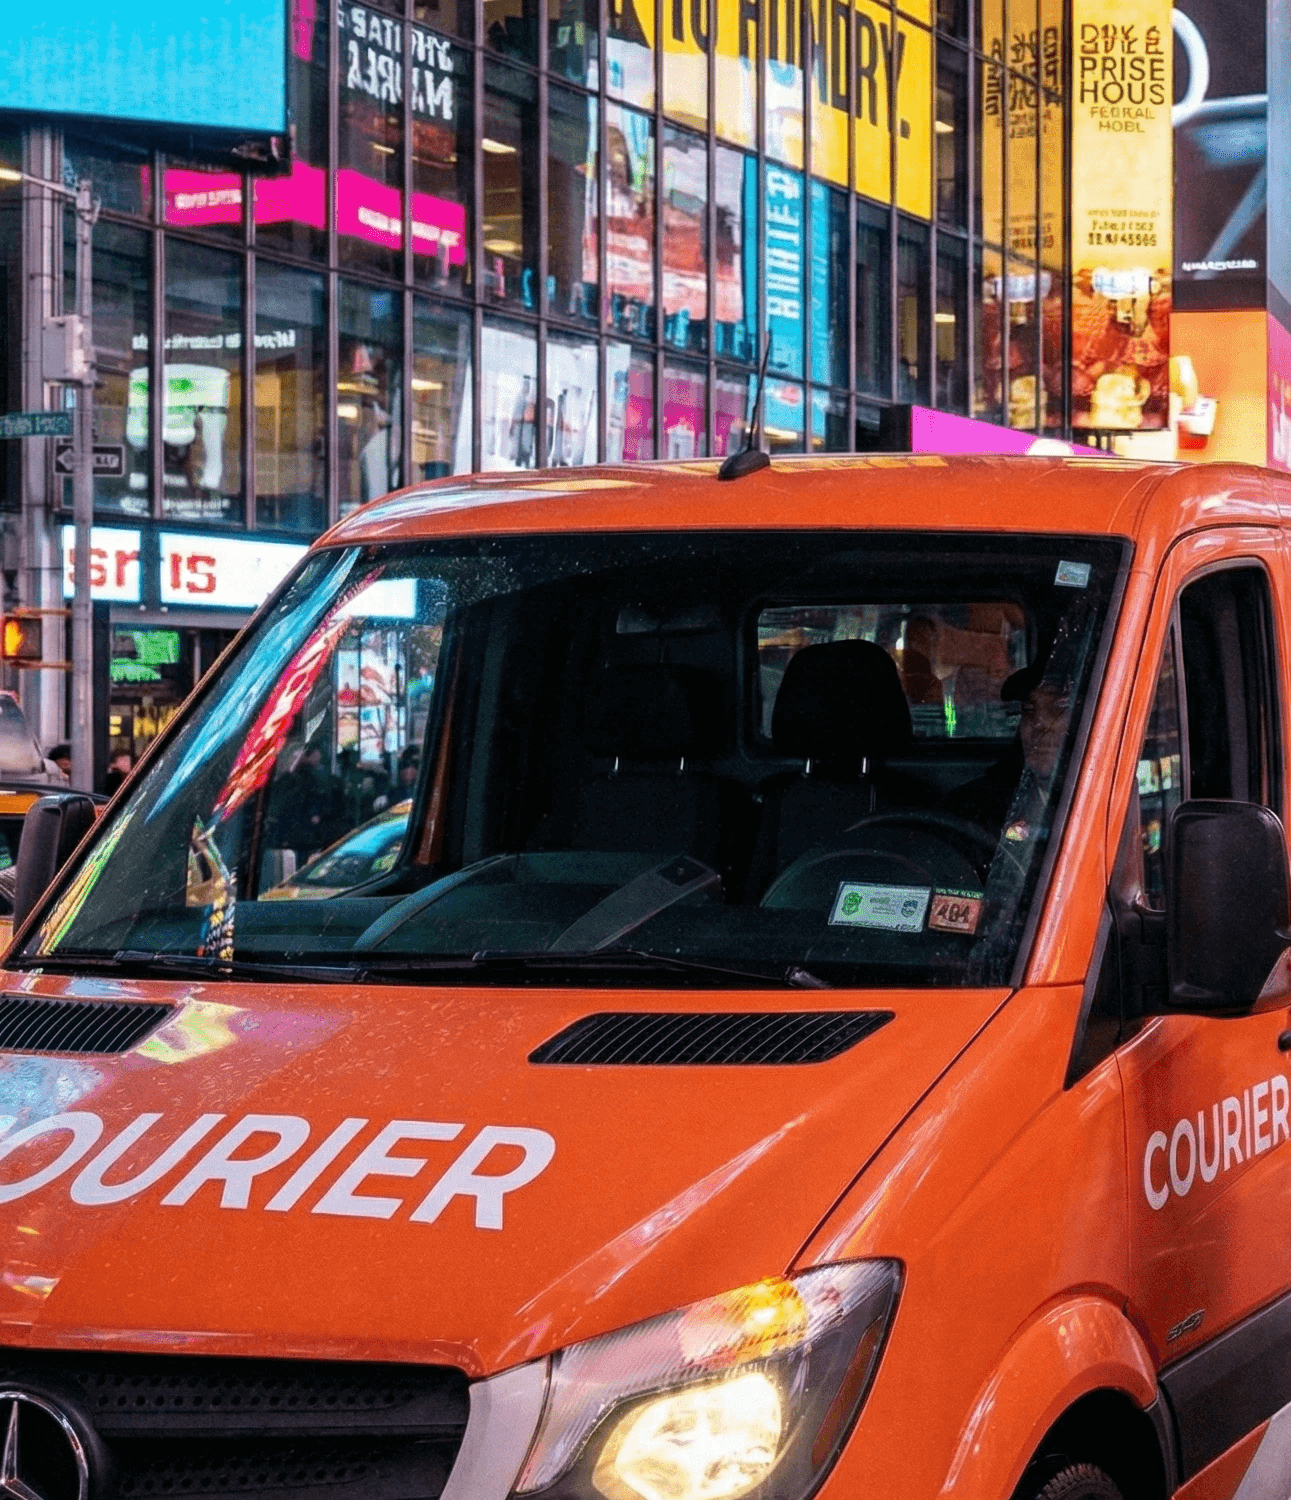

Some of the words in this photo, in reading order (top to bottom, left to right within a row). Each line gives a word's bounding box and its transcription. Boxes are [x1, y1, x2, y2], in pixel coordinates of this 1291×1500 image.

[1080, 56, 1164, 81] PRISE
[1080, 80, 1164, 105] HOUS
[0, 1111, 557, 1230] OURIER
[1143, 1074, 1290, 1211] COURIER
